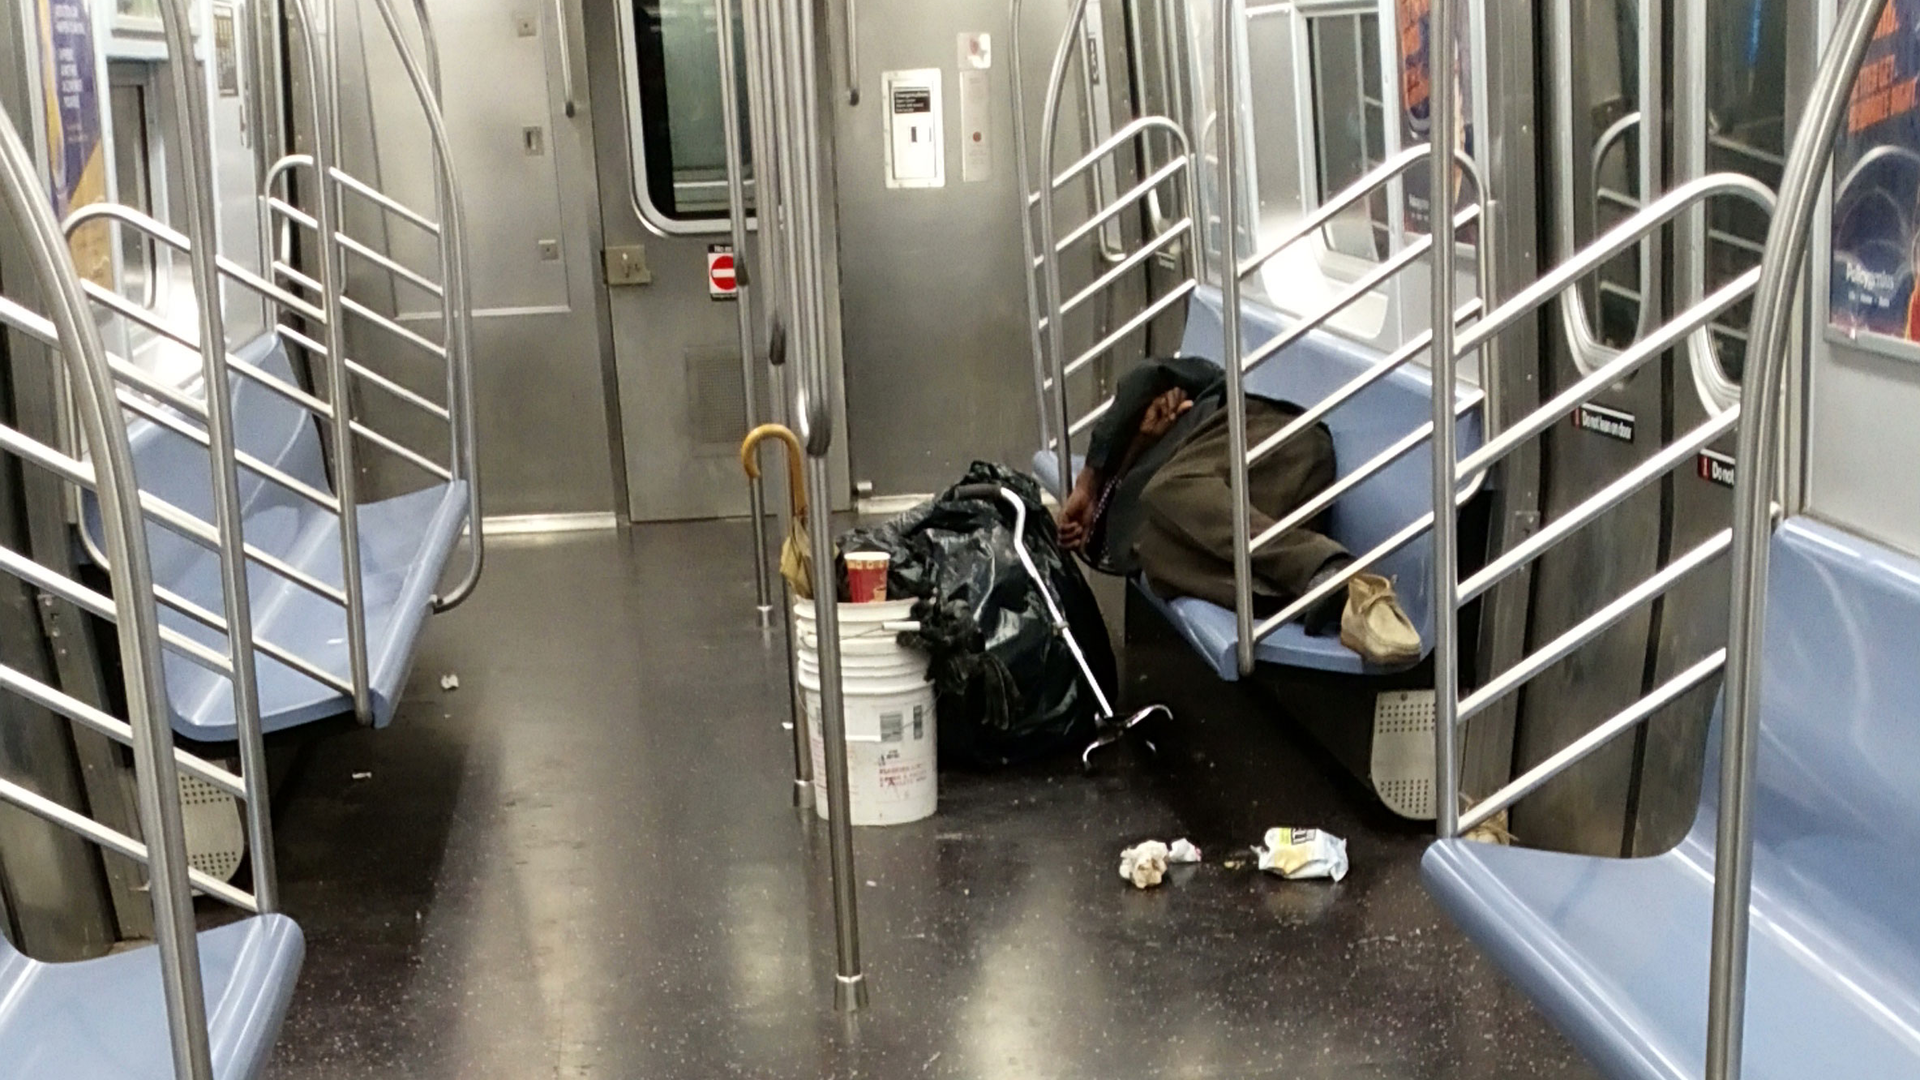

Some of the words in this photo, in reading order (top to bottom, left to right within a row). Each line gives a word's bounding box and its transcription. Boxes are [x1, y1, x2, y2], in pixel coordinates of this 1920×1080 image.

[1582, 410, 1591, 428] Do
[1600, 415, 1611, 433] lean
[1619, 421, 1632, 440] door
[1712, 460, 1722, 481] Do
[1722, 467, 1734, 485] not
